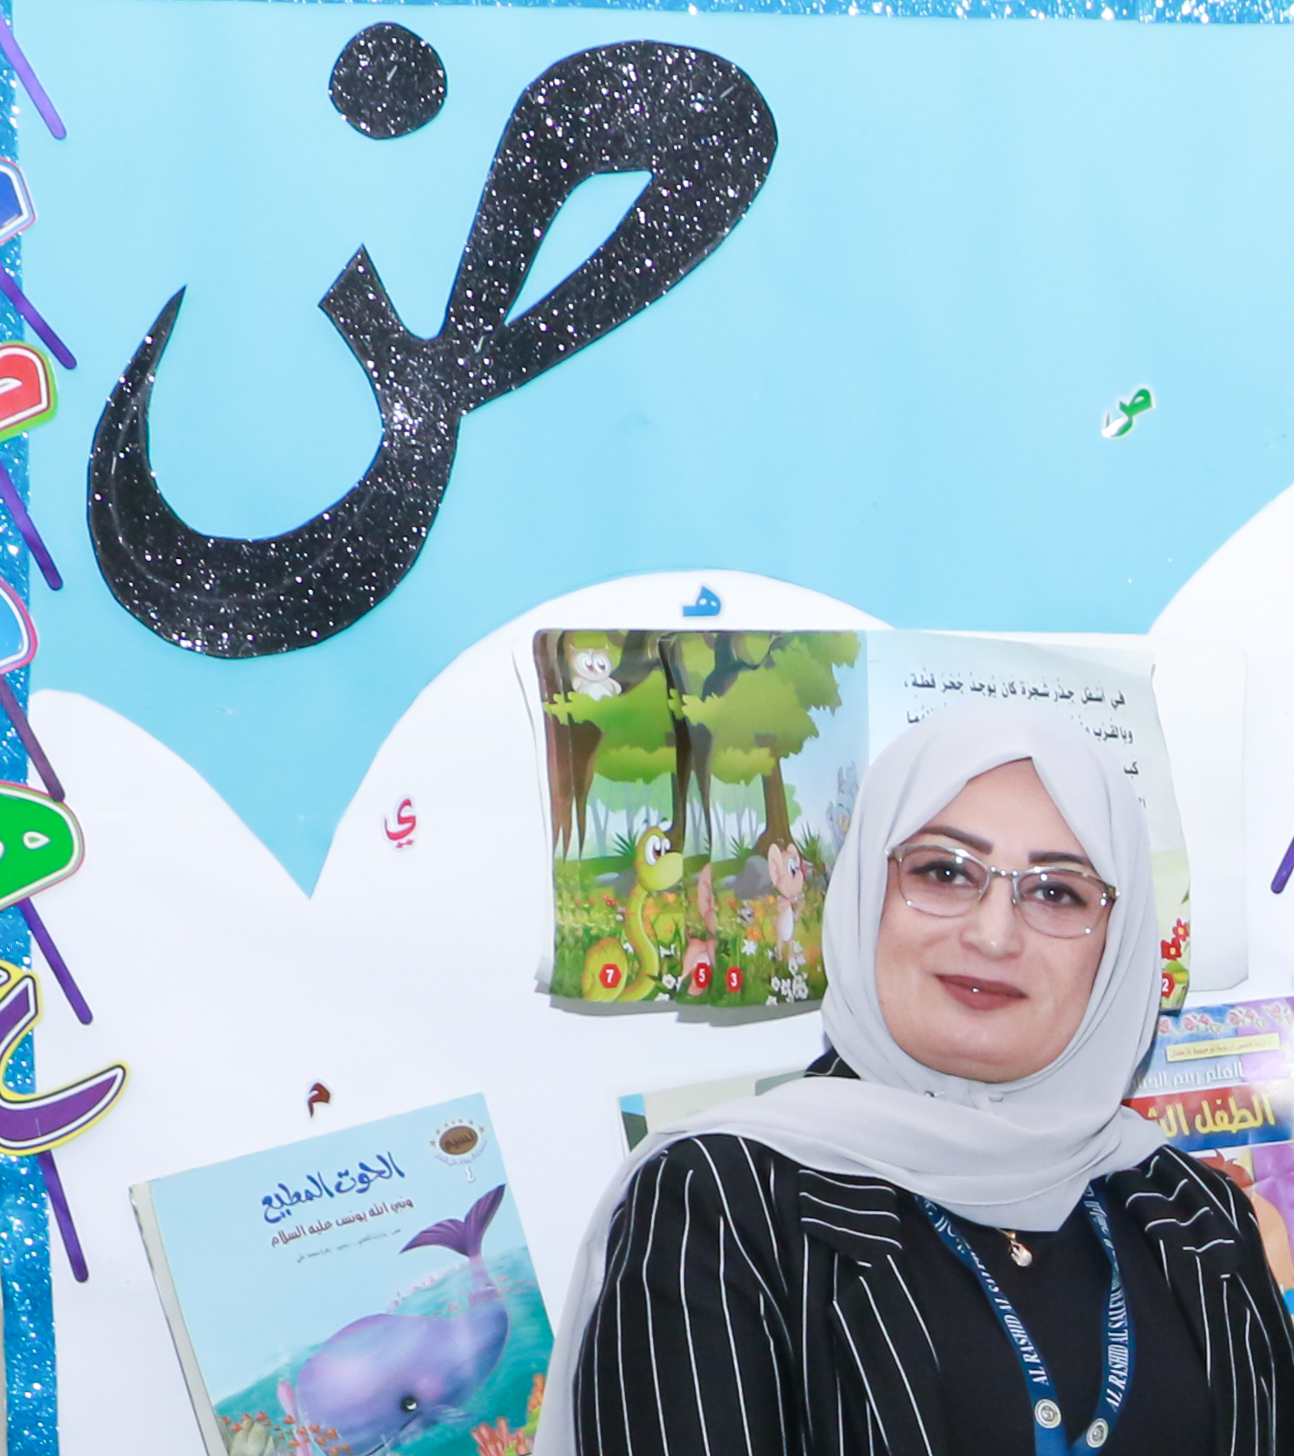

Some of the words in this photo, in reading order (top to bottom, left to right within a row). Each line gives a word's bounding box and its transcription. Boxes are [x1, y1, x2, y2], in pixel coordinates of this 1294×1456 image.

[88, 21, 778, 659] ض
[384, 798, 418, 849] ي
[605, 968, 614, 983] 7
[698, 968, 706, 982] 5
[730, 972, 738, 987] 3
[1162, 978, 1169, 992] 2
[307, 1082, 331, 1118] م
[1194, 1094, 1276, 1134] الطفل
[334, 1151, 405, 1193] الحوت
[261, 1171, 335, 1224] المطيع
[336, 1210, 368, 1228] يونس
[368, 1202, 388, 1217] الله
[271, 1225, 307, 1247] السلام
[309, 1221, 332, 1236] عليه
[1003, 1314, 1041, 1365] RASHID
[1107, 1328, 1128, 1345] AL
[1027, 1364, 1050, 1386] AL
[1107, 1344, 1129, 1392] RASHID
[1104, 1392, 1123, 1412] AL
